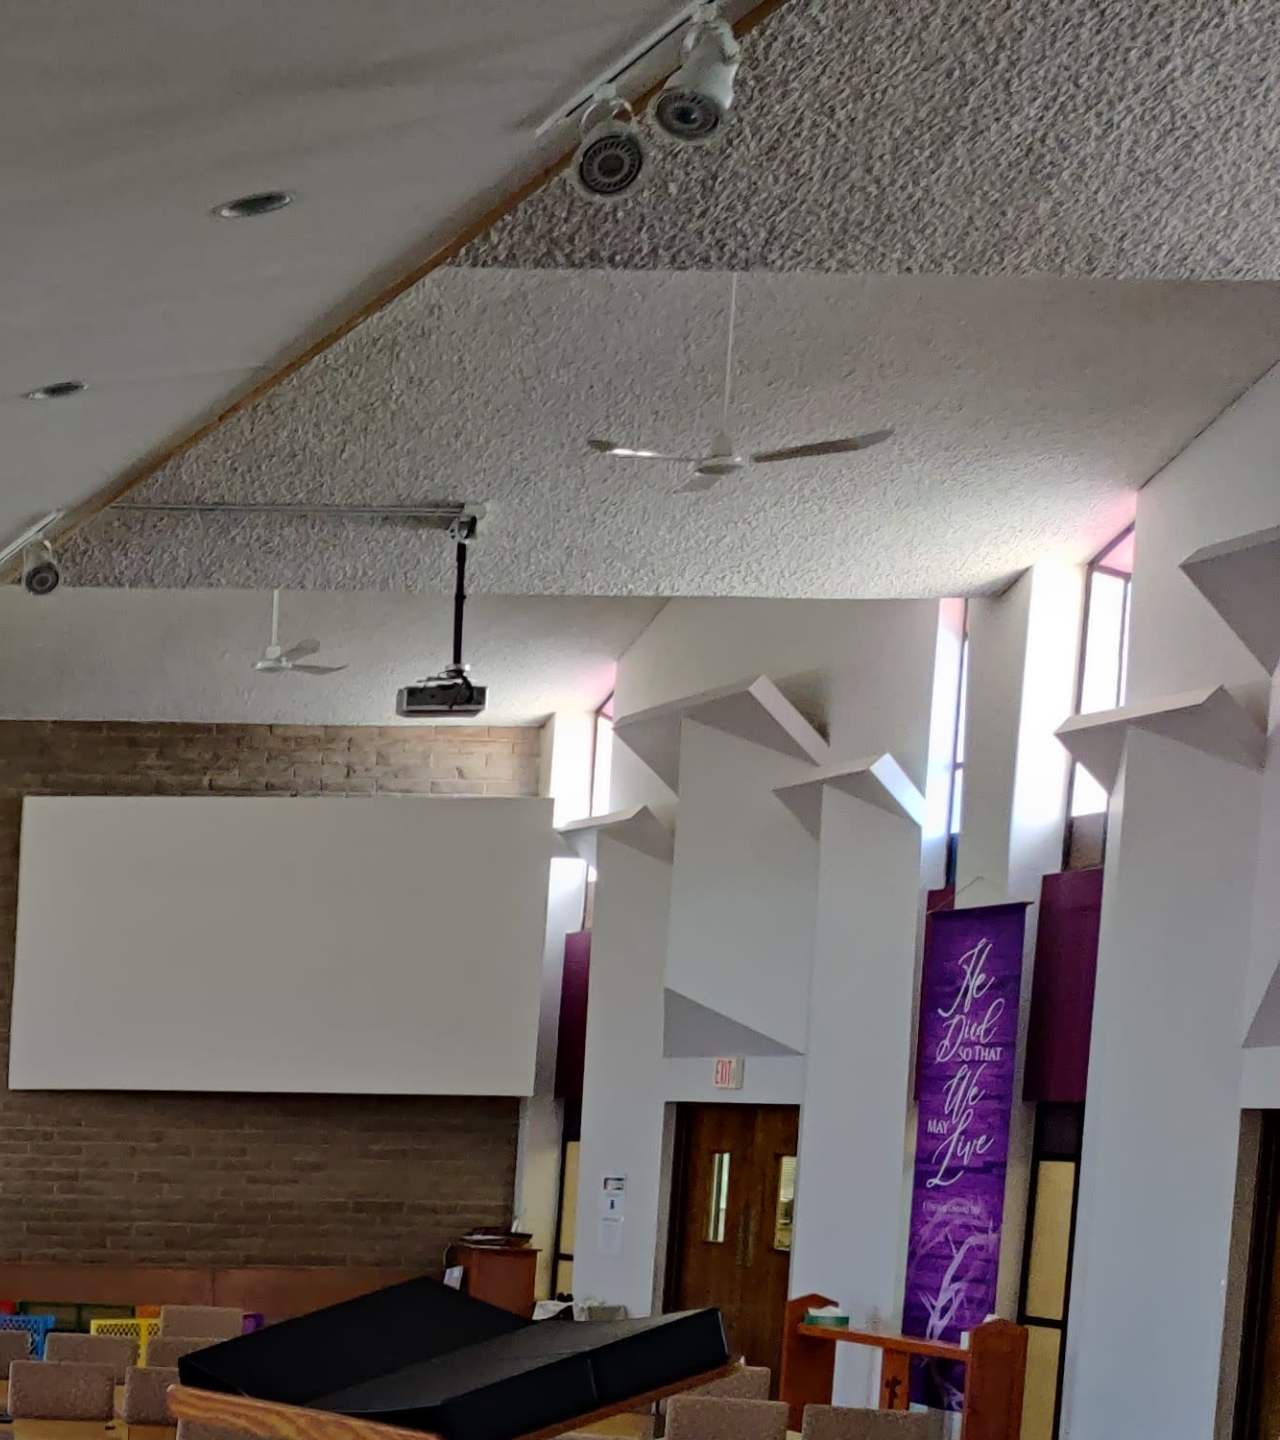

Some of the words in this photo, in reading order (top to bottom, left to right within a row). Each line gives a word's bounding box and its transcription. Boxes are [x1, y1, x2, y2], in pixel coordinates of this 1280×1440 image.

[938, 938, 995, 1017] He
[714, 1059, 732, 1085] EXIT
[958, 1045, 973, 1061] SO
[974, 1045, 1003, 1061] THAT
[942, 1063, 987, 1124] We
[926, 1108, 994, 1188] Live
[927, 1119, 949, 1135] MAY
